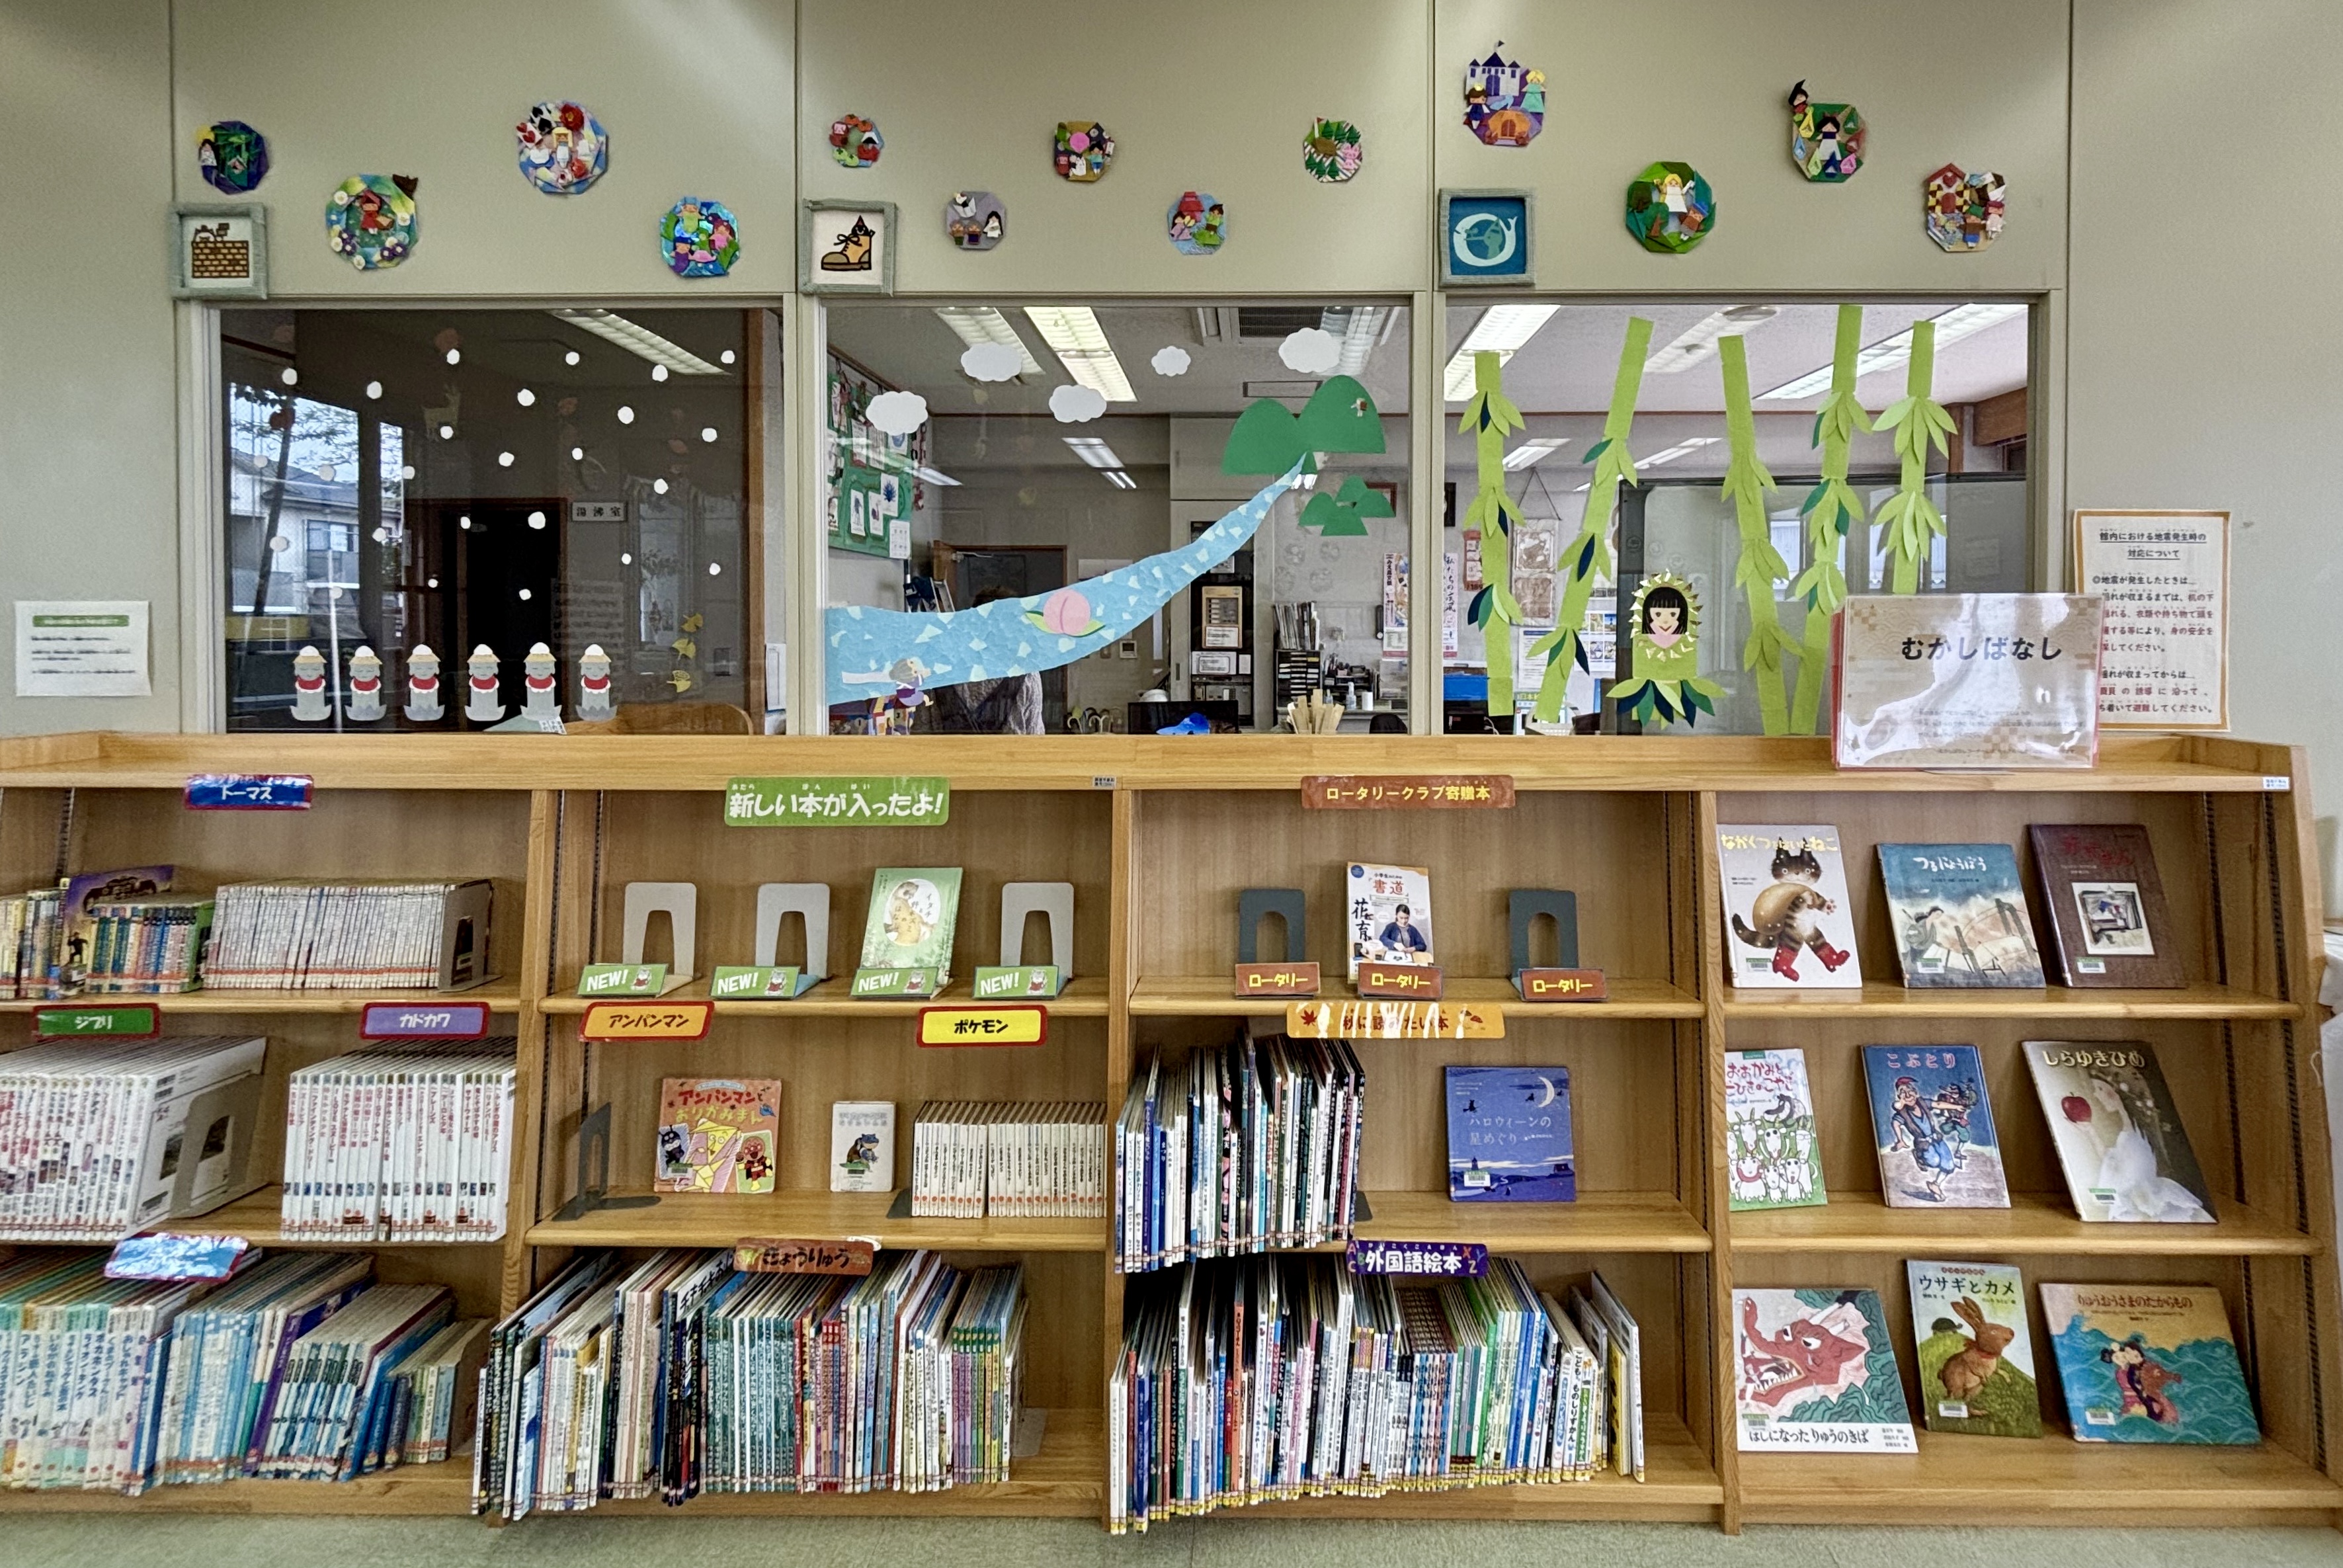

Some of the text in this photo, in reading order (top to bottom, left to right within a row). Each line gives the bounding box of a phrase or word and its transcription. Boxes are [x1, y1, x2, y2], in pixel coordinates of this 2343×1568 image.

[1902, 637, 2062, 660] むかしばなし
[222, 786, 272, 800] トーマス
[1327, 786, 1490, 801] ロータリークラブ寄贈本
[729, 793, 943, 817] 新しい本が入ったよ!
[587, 970, 628, 991] NEW!
[718, 972, 759, 995] NEW!
[859, 972, 899, 992] NEW!
[981, 973, 1020, 995] NEW!
[1249, 973, 1308, 987] ロータリー
[1372, 973, 1430, 989] ロータリー
[1534, 979, 1592, 993] ロータリー
[75, 1015, 112, 1029] ジブリ
[400, 1014, 450, 1028] カドカワ
[609, 1014, 689, 1028] アンパンマン
[954, 1019, 1008, 1034] ポケモン
[1887, 1053, 1955, 1069] こぶとり
[2044, 1050, 2145, 1068] しらゆきひめ
[1727, 1062, 1786, 1079] おおかみと
[676, 1106, 763, 1124] おりがみまん
[1469, 1116, 1551, 1128] ハロウィーンの
[1470, 1132, 1516, 1145] 星めぐり
[762, 1247, 850, 1268] きょうりゅう
[1365, 1250, 1461, 1274] 外国語絵本
[1920, 1275, 2014, 1296] ウサギとカメ
[1749, 1428, 1809, 1442] はしになった
